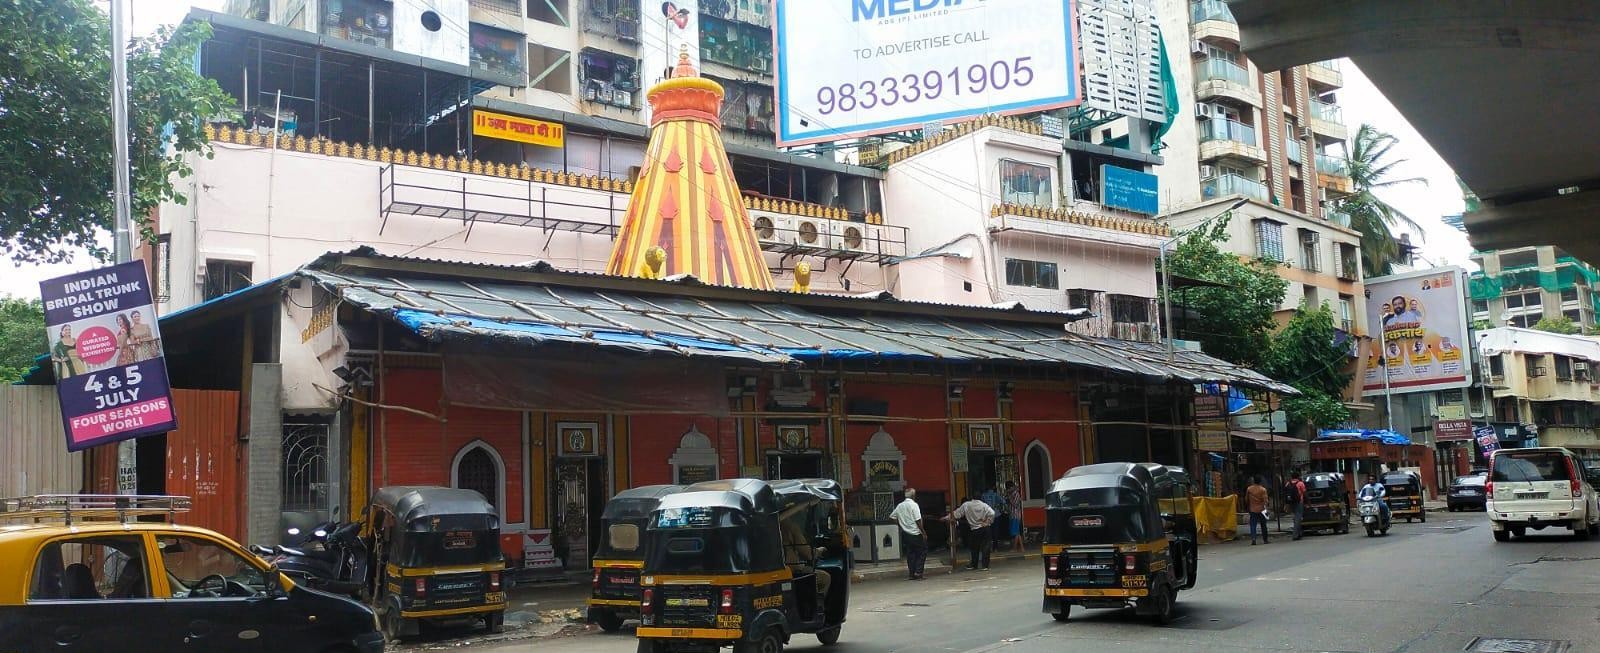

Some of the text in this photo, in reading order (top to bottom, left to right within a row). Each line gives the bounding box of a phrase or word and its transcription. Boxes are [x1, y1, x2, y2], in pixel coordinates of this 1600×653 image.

[914, 10, 949, 20] LIMITED
[853, 30, 990, 60] TO ADVERTISE CALL
[817, 56, 1034, 115] 9833391905
[46, 281, 141, 310] BRIDAL TRUNK
[64, 272, 118, 294] INDIAN
[72, 298, 119, 317] SHOW
[84, 365, 142, 393] 4 & 5
[95, 387, 140, 409] JULY
[73, 400, 167, 429] FOUR SEASONS
[102, 417, 144, 433] WORLI
